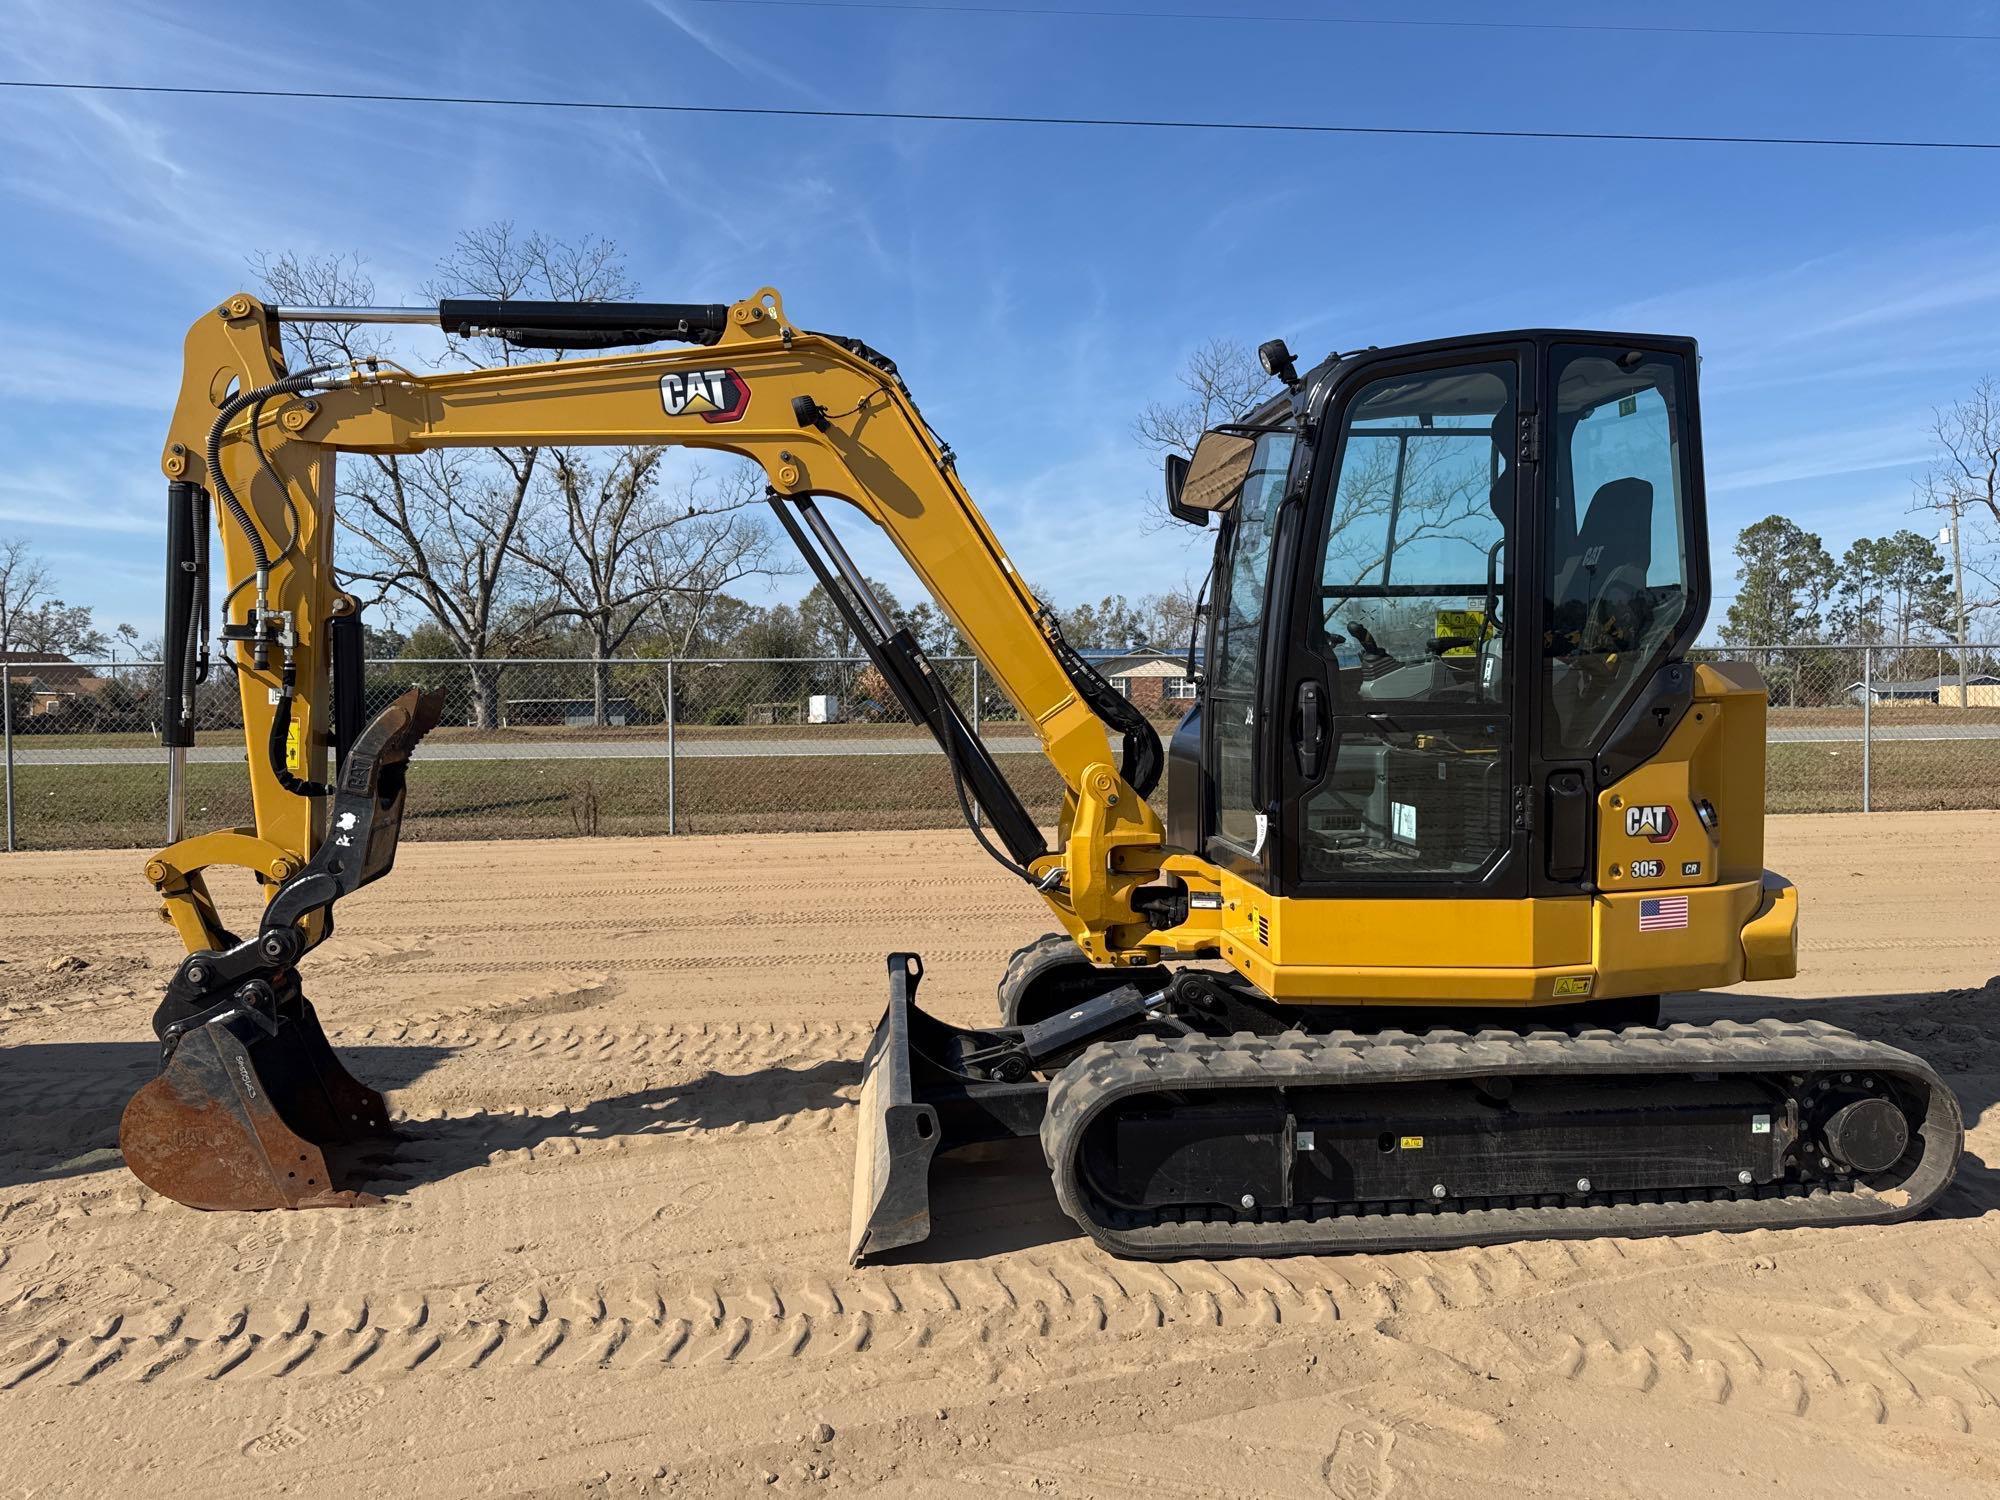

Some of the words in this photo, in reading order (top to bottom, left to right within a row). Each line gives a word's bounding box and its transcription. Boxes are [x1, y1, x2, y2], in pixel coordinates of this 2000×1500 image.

[661, 370, 726, 415] CAT
[1627, 806, 1667, 836] CAT
[1631, 860, 1658, 877] 305
[1685, 863, 1698, 874] CR
